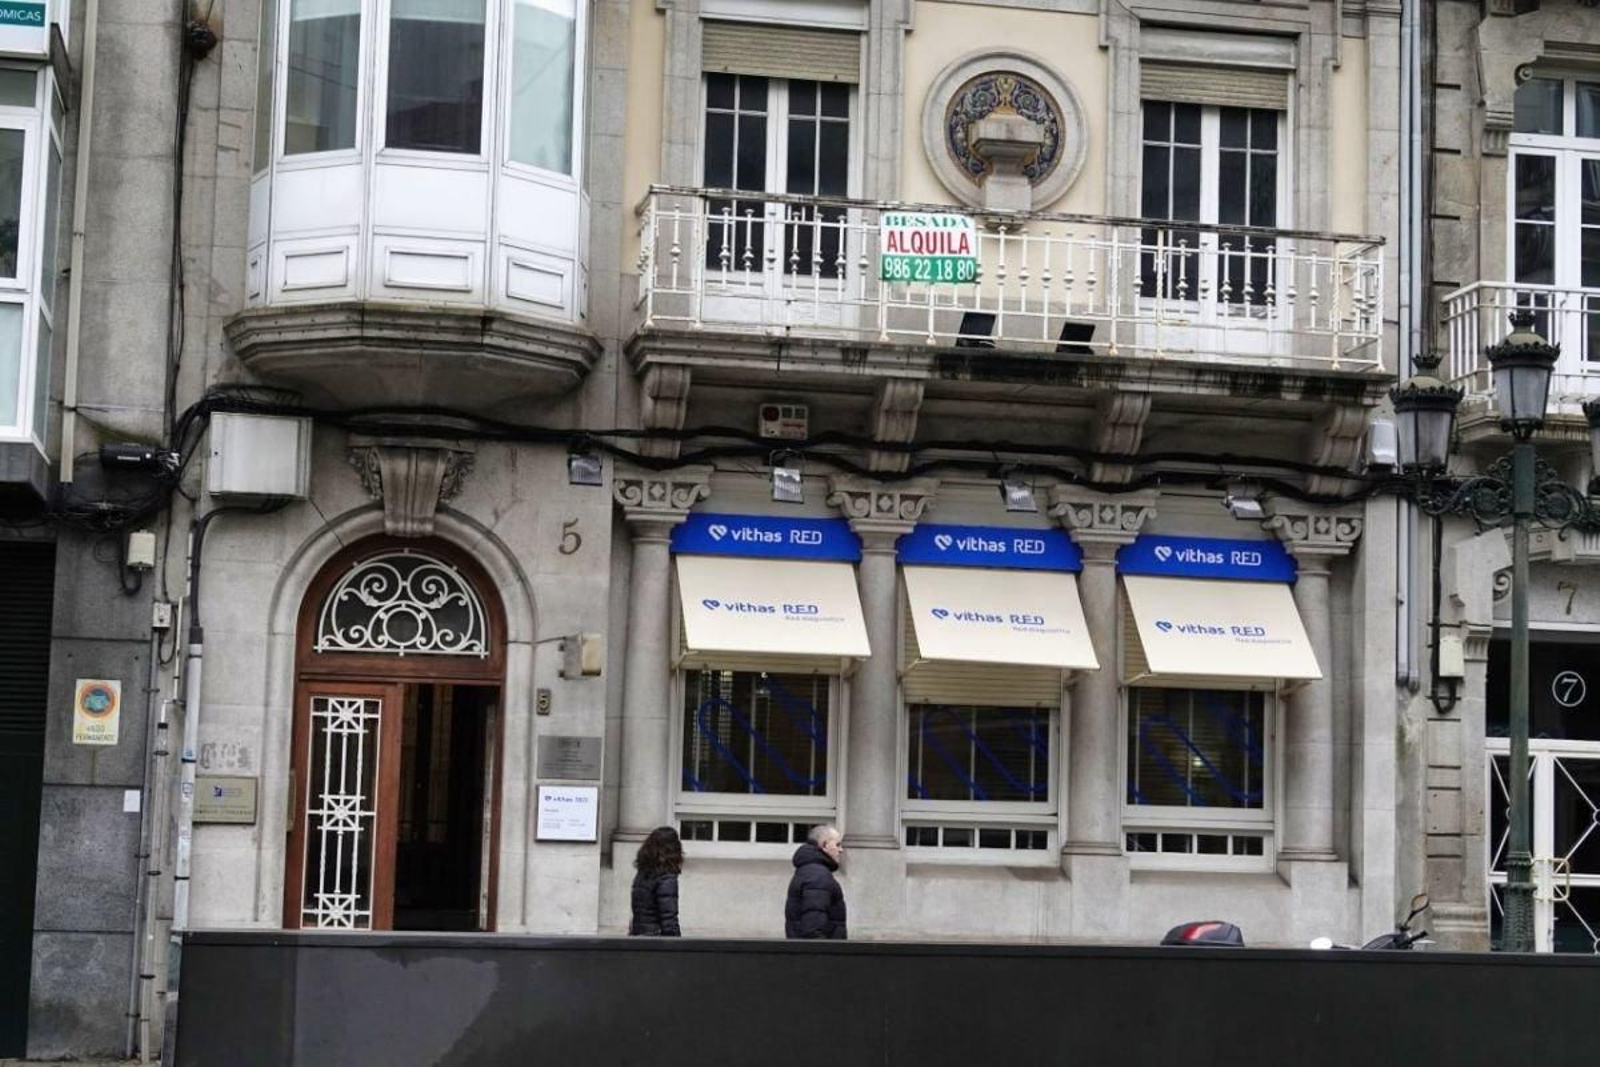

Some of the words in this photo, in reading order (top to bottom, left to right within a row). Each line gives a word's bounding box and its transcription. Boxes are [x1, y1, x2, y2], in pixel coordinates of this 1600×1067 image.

[885, 216, 969, 228] BESADA
[887, 230, 970, 254] ALQUILA
[885, 257, 910, 278] 986
[914, 258, 932, 279] 22
[936, 259, 953, 280] 18
[957, 259, 975, 280] 80
[558, 517, 582, 555] 5
[731, 527, 782, 543] vithas
[789, 530, 822, 544] RED
[957, 537, 1006, 553] vithas
[1014, 539, 1045, 554] RED
[1176, 549, 1224, 564] vithas
[1231, 551, 1262, 566] RED
[1557, 581, 1577, 615] 7
[725, 602, 776, 613] vithas
[783, 604, 818, 614] RED
[953, 611, 1003, 623] vithas
[1010, 614, 1044, 625] RED
[1177, 624, 1225, 635] vithas
[1231, 626, 1265, 636] RED
[1561, 677, 1579, 702] 7
